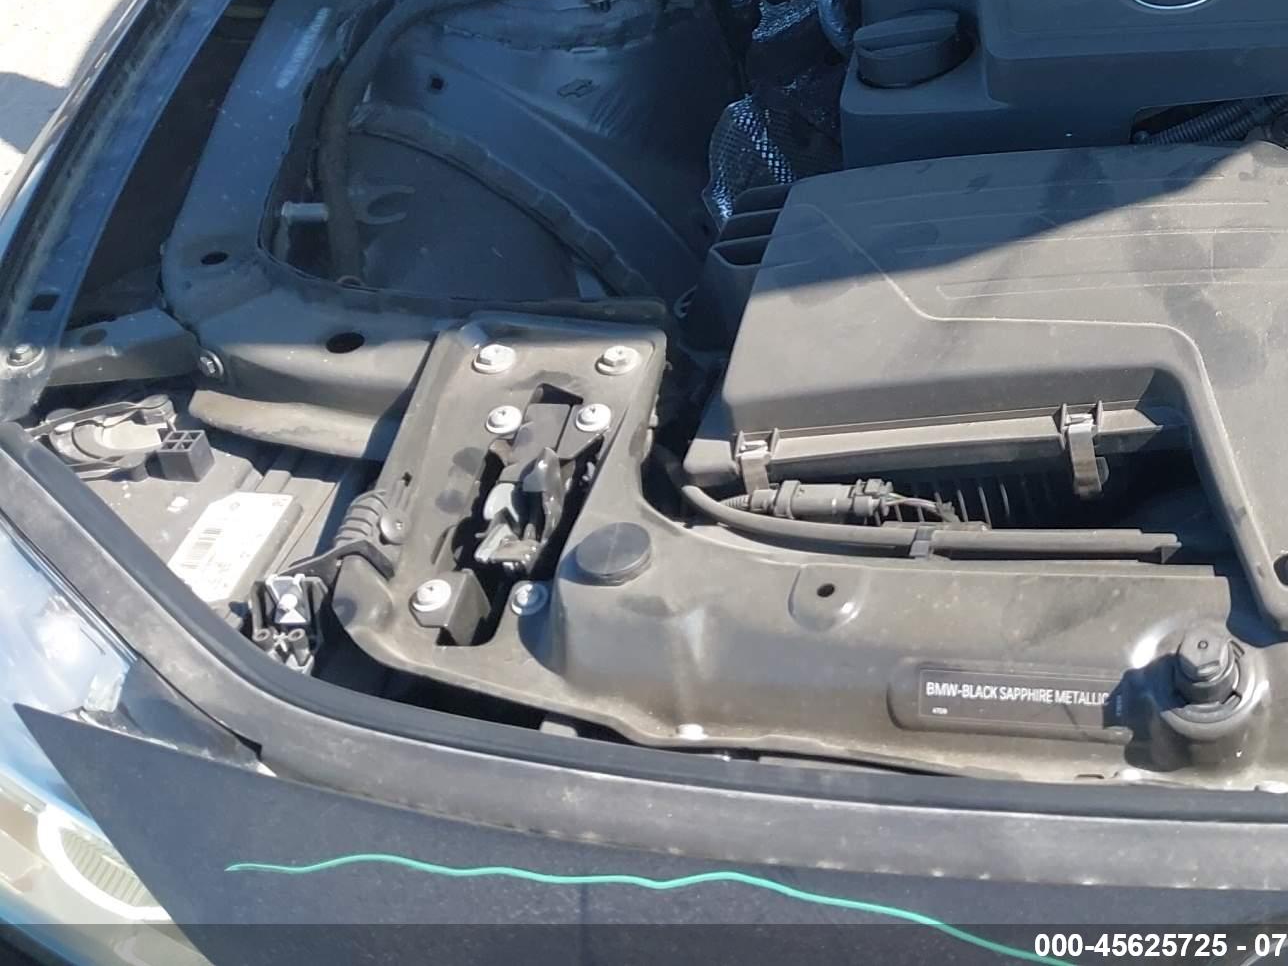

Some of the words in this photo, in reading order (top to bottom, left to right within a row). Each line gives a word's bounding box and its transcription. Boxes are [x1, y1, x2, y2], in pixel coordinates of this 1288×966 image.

[925, 681, 999, 699] BMW-BLACK
[999, 687, 1054, 704] SAPPHIRE
[1054, 689, 1110, 706] METALLIC
